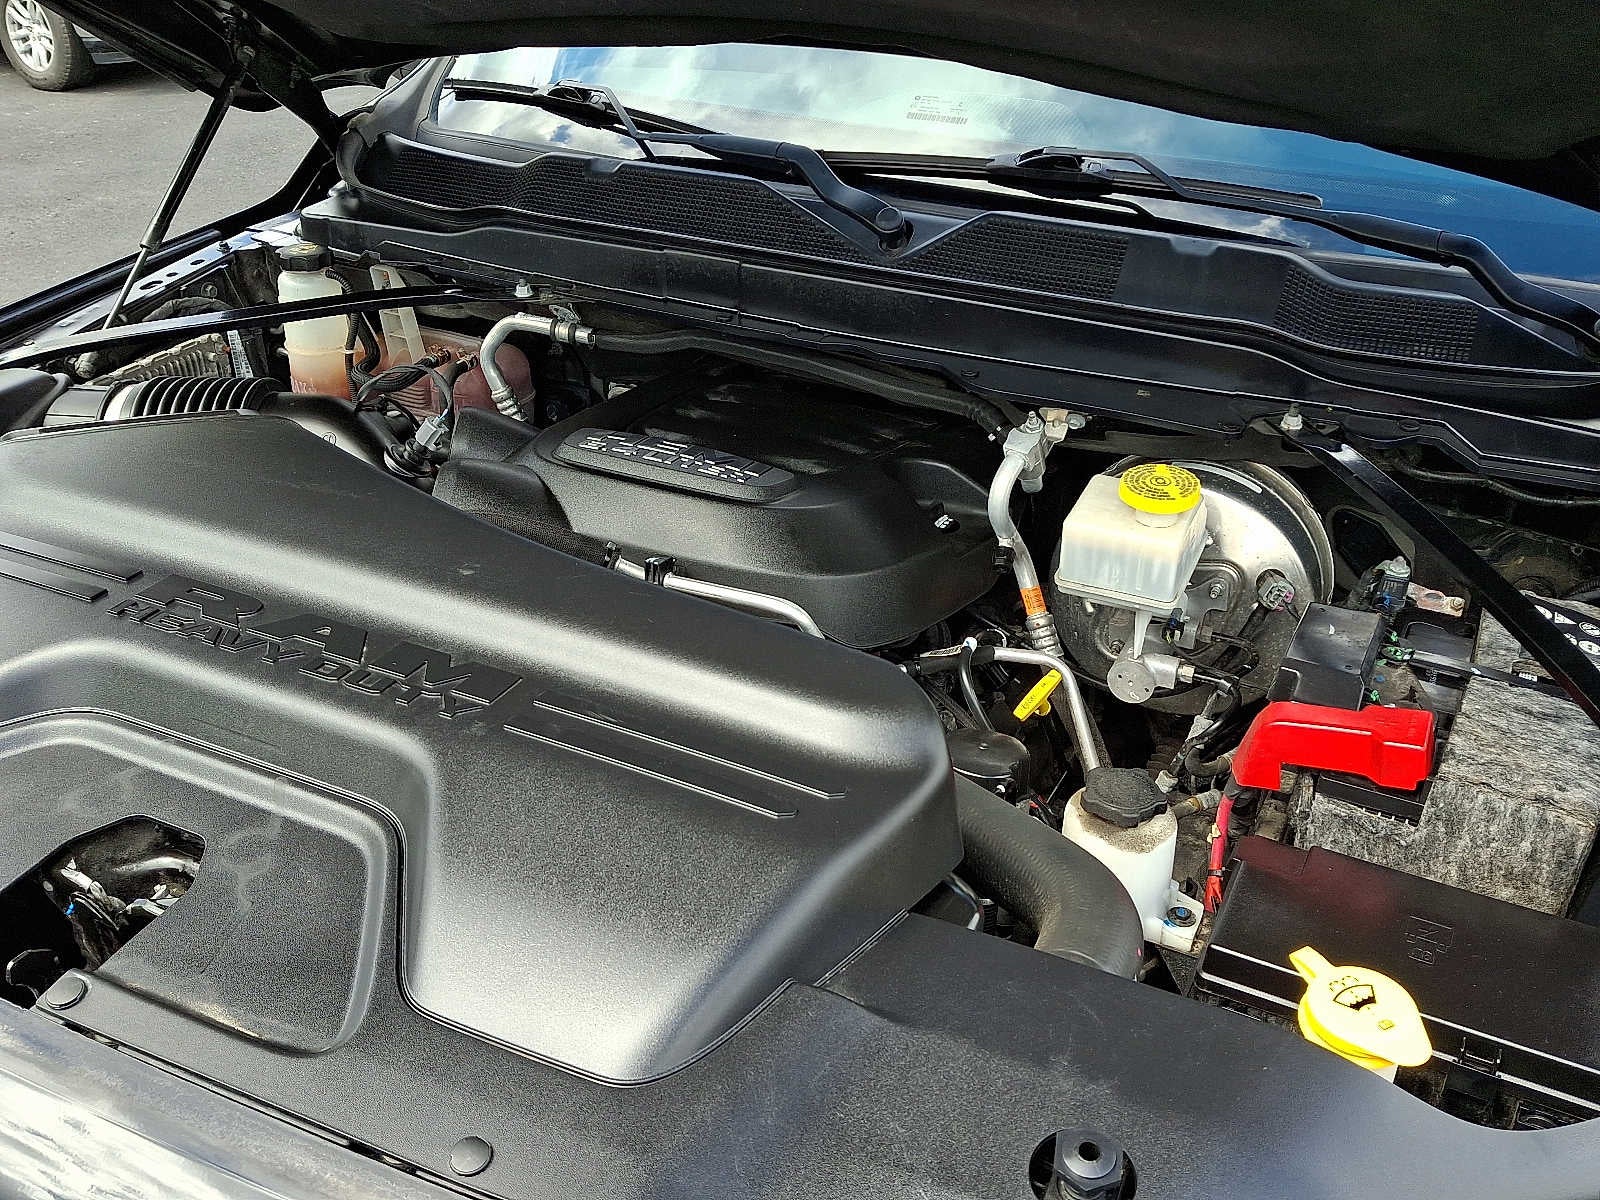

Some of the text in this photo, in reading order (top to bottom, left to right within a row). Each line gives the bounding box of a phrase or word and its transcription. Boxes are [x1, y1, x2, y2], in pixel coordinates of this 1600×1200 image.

[586, 430, 774, 477] HEMI
[106, 598, 491, 719] HEAVY DUTY
[133, 574, 523, 704] RAM
